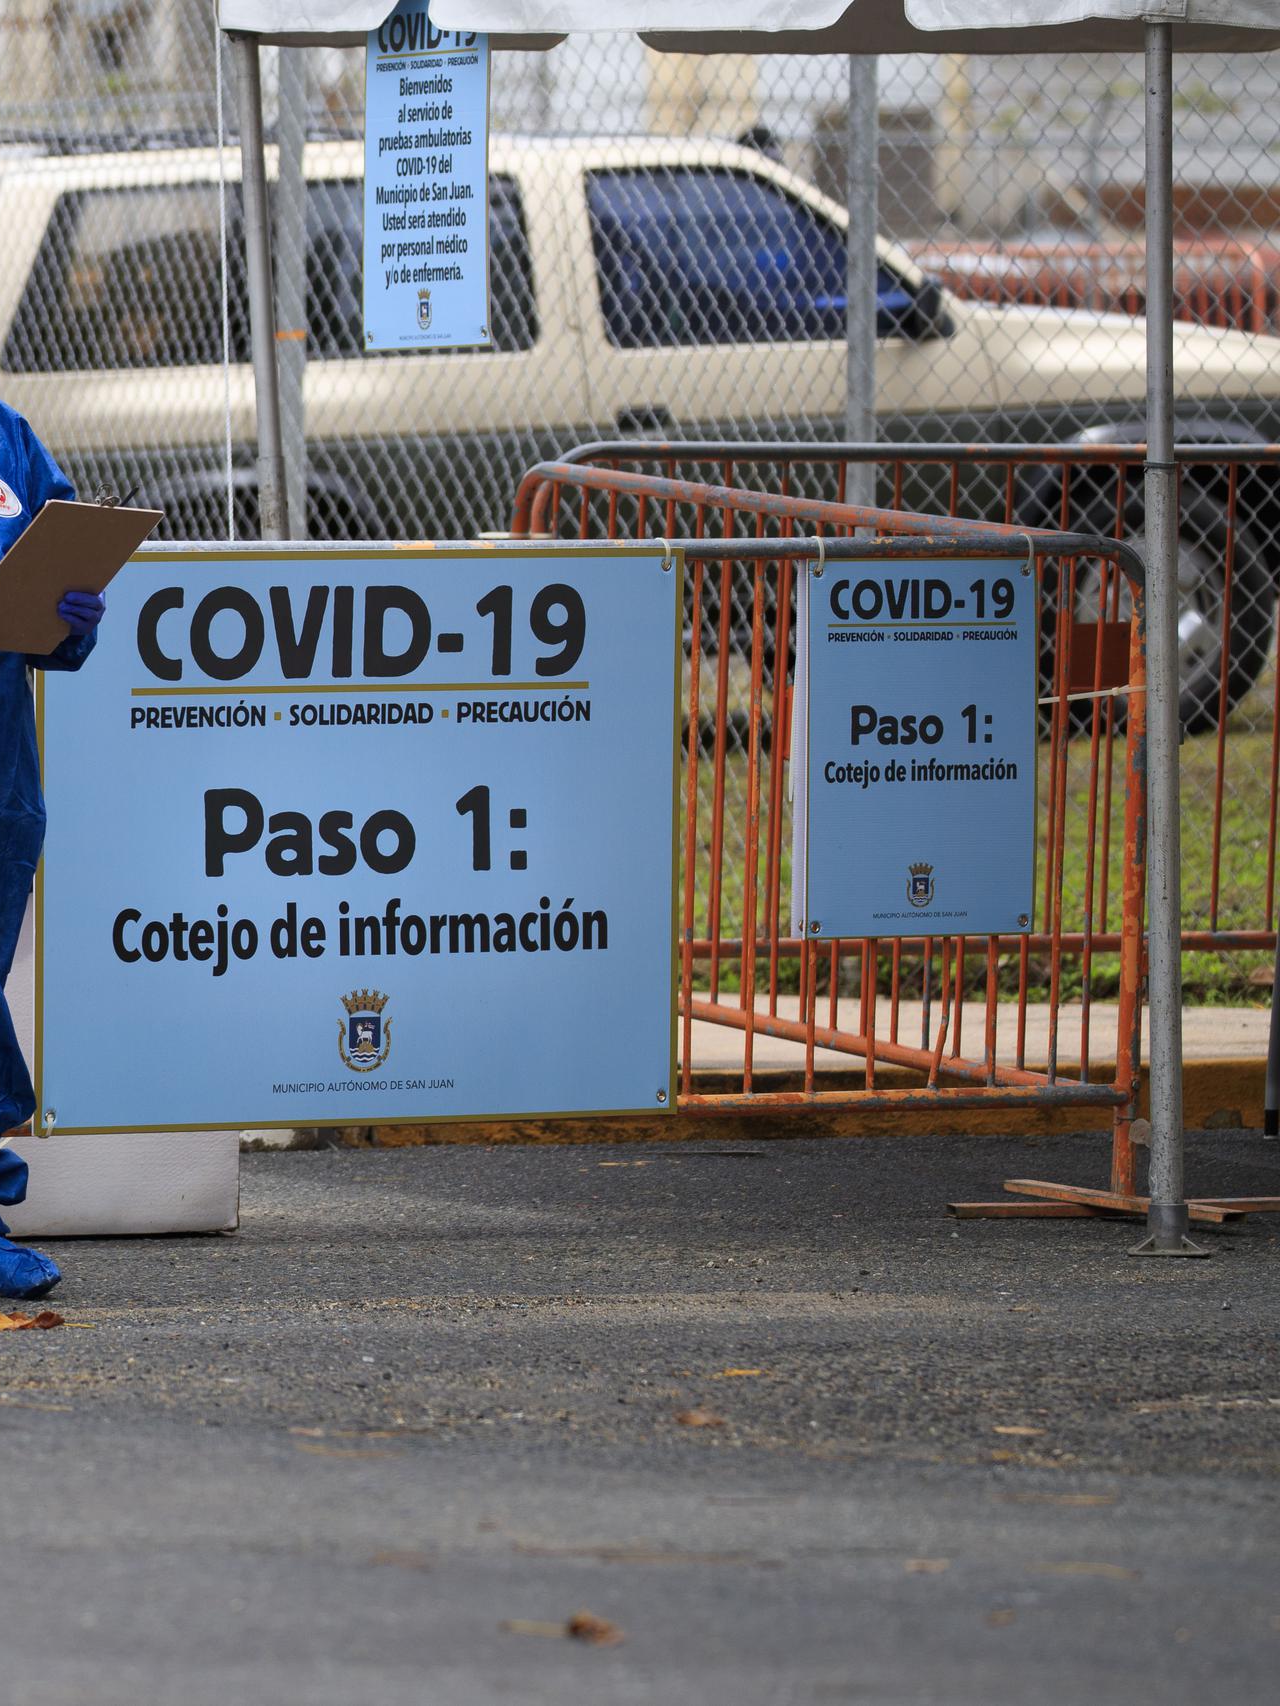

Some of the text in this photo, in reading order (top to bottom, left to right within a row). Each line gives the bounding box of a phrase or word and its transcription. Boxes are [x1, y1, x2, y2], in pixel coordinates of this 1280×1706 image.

[400, 74, 452, 96] Bienvenidos
[398, 101, 452, 122] al servicio de
[379, 126, 471, 156] pruebas ambulatorias
[397, 154, 452, 176] COVID-19 del
[376, 183, 473, 208] Municipio de San Juan.
[383, 207, 466, 231] Usted será atendido
[382, 234, 467, 263] por personal médico
[386, 262, 463, 289] y/o de enfermería.
[829, 578, 1016, 620] COVID-19
[136, 583, 586, 681] COVID-19
[828, 629, 1018, 642] PREVENCIÓN SOLIDARIDAD PRECAUCIÓN
[129, 698, 591, 730] PREVENCIÓN SOLIDARIDAD PRECAUCIÓN
[851, 704, 993, 746] Paso 1:
[824, 757, 1017, 789] Cotejo de información
[204, 784, 528, 878] Paso 1:
[112, 896, 609, 977] Cotejo de información
[272, 1078, 455, 1095] MUNICIPIO AUTÓNOMO DE SAN JUAN
